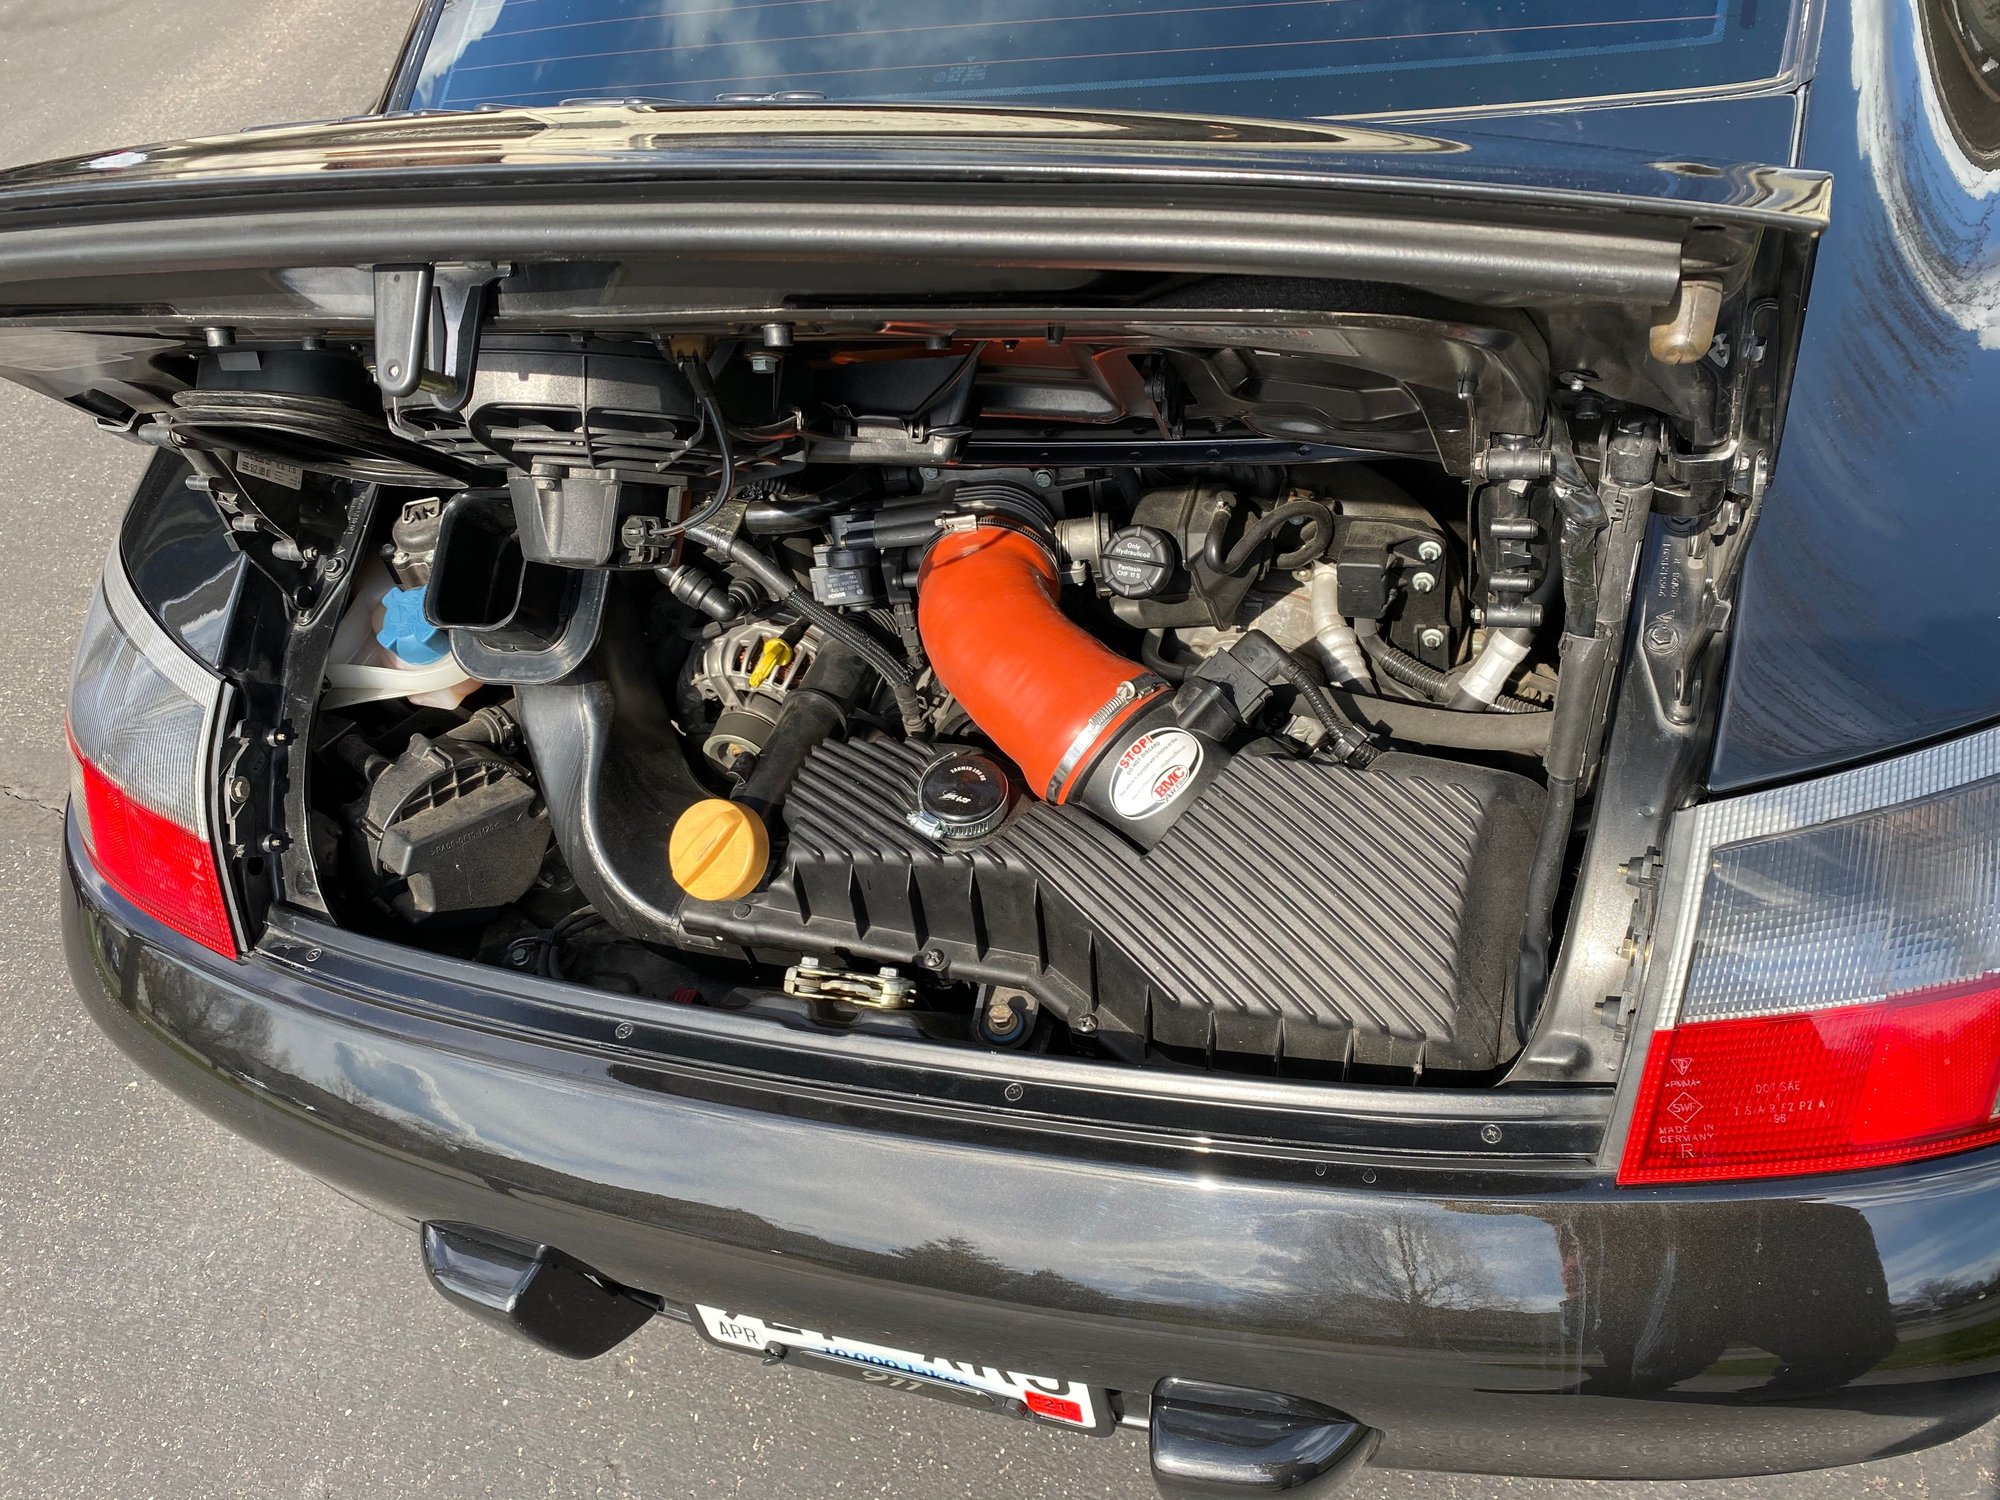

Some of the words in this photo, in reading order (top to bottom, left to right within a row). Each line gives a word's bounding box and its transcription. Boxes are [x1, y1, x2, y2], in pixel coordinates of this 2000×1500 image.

[1127, 542, 1141, 550] Only
[1118, 564, 1142, 572] Pentosin
[1120, 734, 1153, 769] STOP!
[1126, 767, 1134, 776] DO
[1132, 757, 1141, 768] NOT
[1140, 741, 1160, 758] DISCARD
[1154, 766, 1185, 798] BMC
[1755, 1083, 1776, 1094] DOT
[1780, 1080, 1801, 1092] SAE
[1672, 1103, 1696, 1113] SWF
[1658, 1124, 1690, 1134] MADE
[1703, 1124, 1714, 1132] IN
[1659, 1133, 1714, 1144] GERMANY
[1680, 1144, 1695, 1158] R
[718, 1320, 760, 1345] APR
[862, 1370, 924, 1391] 911
[1044, 1398, 1066, 1412] 21
